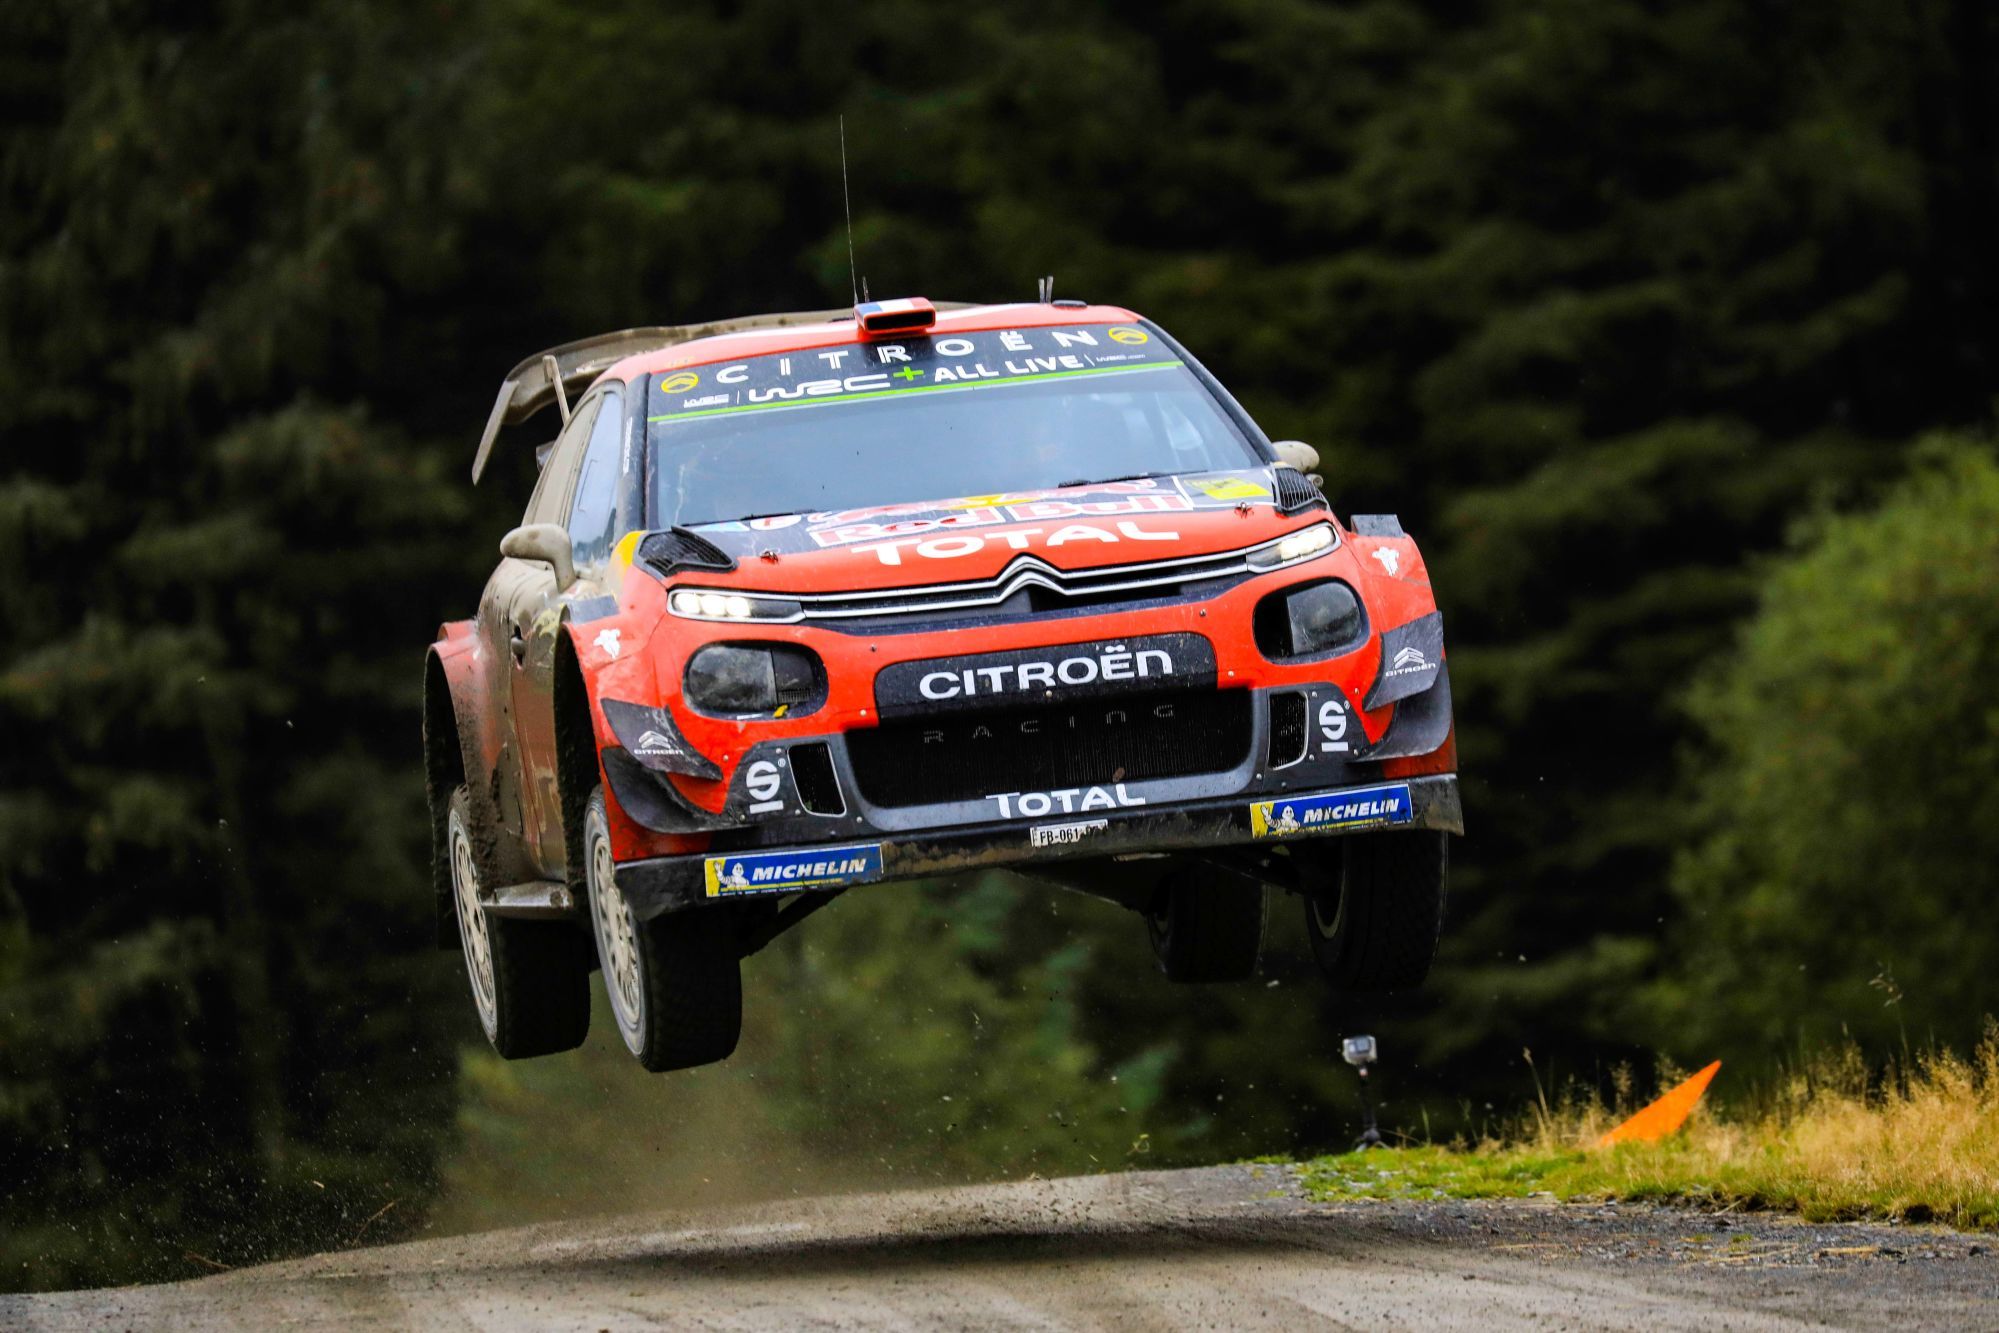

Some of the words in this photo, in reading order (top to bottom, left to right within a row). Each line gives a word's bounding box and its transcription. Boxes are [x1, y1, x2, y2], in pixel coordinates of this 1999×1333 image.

[716, 331, 1098, 384] CITROËN
[934, 364, 999, 382] ALL
[1005, 355, 1084, 374] LIVE
[808, 504, 1005, 548] Red
[1003, 494, 1194, 521] Bull
[851, 521, 1180, 565] TOTAL
[986, 783, 1146, 819] TOTAL
[1303, 798, 1400, 823] MICHELIN
[752, 858, 867, 881] MICHELIN
